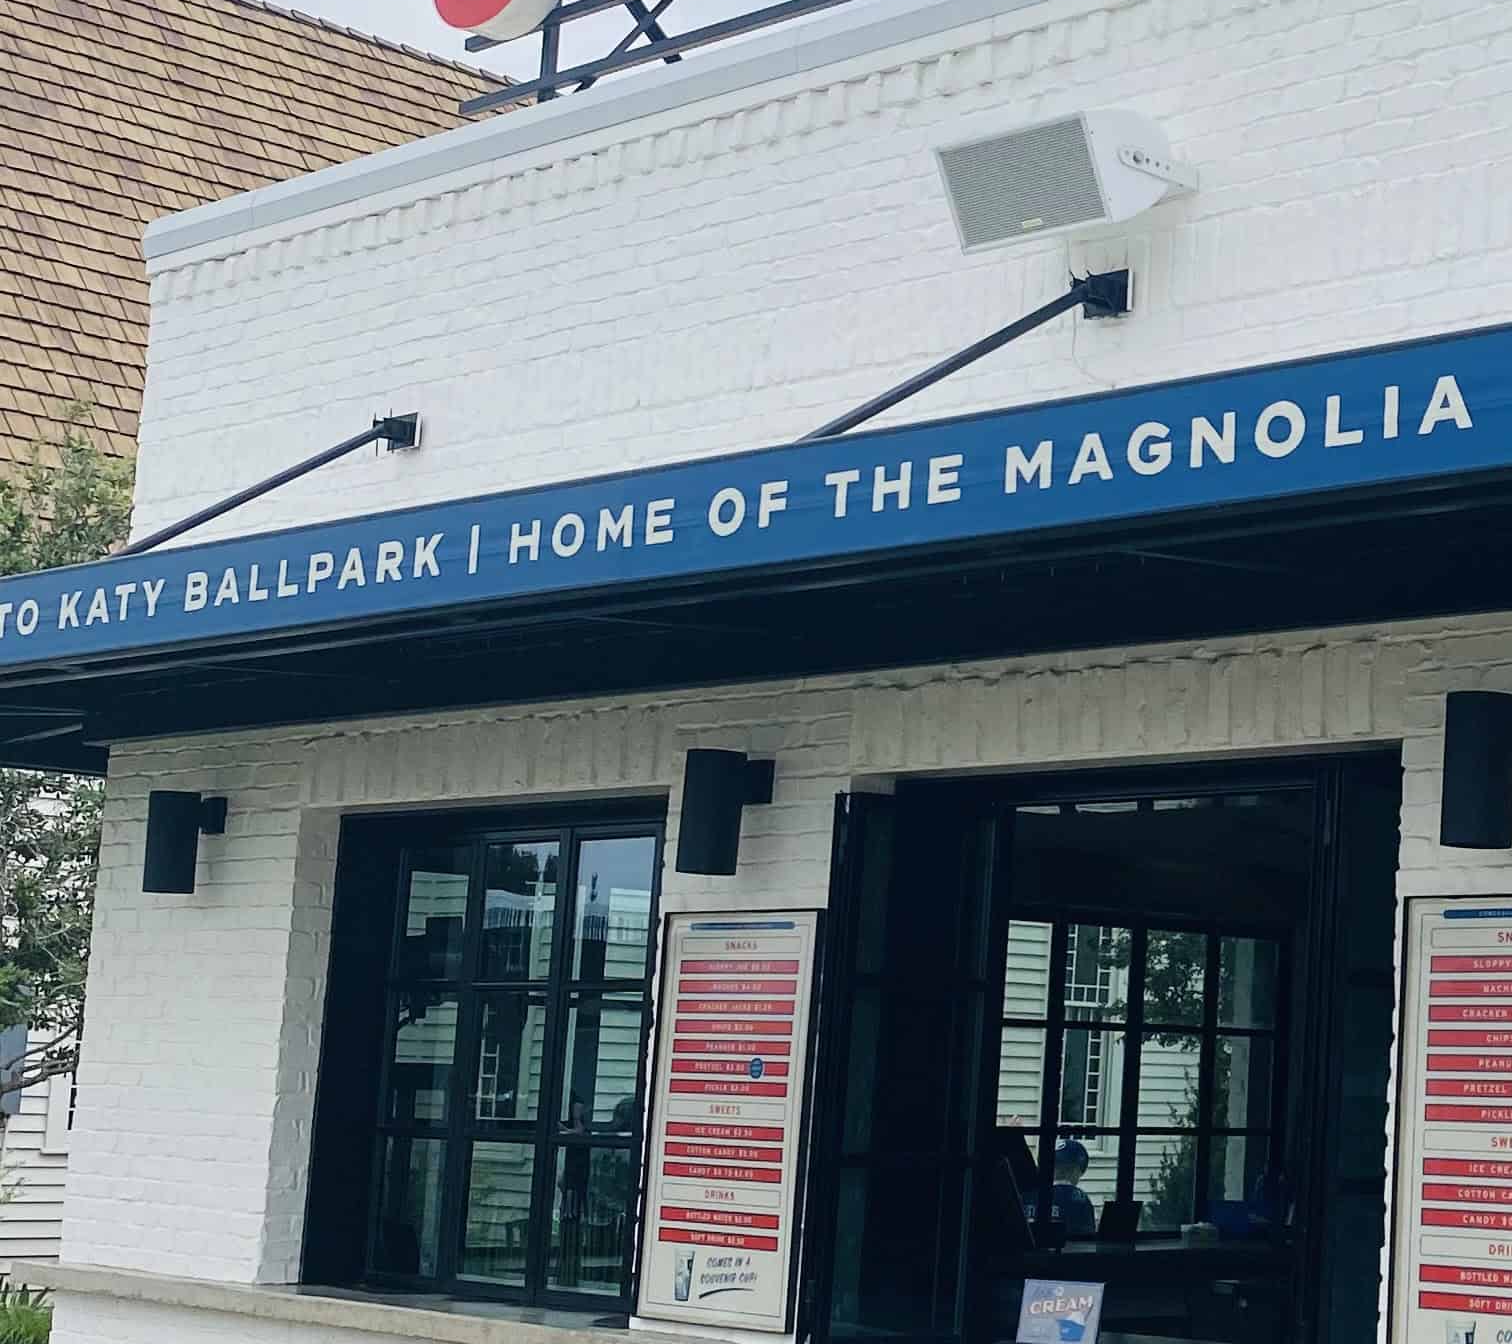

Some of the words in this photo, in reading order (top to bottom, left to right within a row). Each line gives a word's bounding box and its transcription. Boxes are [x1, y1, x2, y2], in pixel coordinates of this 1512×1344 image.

[0, 599, 40, 640] TO
[58, 578, 166, 630] KATY
[184, 532, 444, 612] BALLPARK
[508, 497, 675, 563] HOME
[708, 480, 789, 538] OF
[826, 453, 964, 518] THE
[1004, 374, 1473, 496] MAGNOLIA
[1472, 959, 1511, 969] SLOPPY
[1463, 1084, 1507, 1094] PRETZEL
[1469, 1163, 1485, 1173] ICE
[1457, 1189, 1496, 1199] COTTON
[1462, 1215, 1496, 1225] CANDY
[1460, 1271, 1499, 1283] BOTTLED
[1030, 1296, 1093, 1314] CREAM
[1469, 1299, 1491, 1309] SOFT
